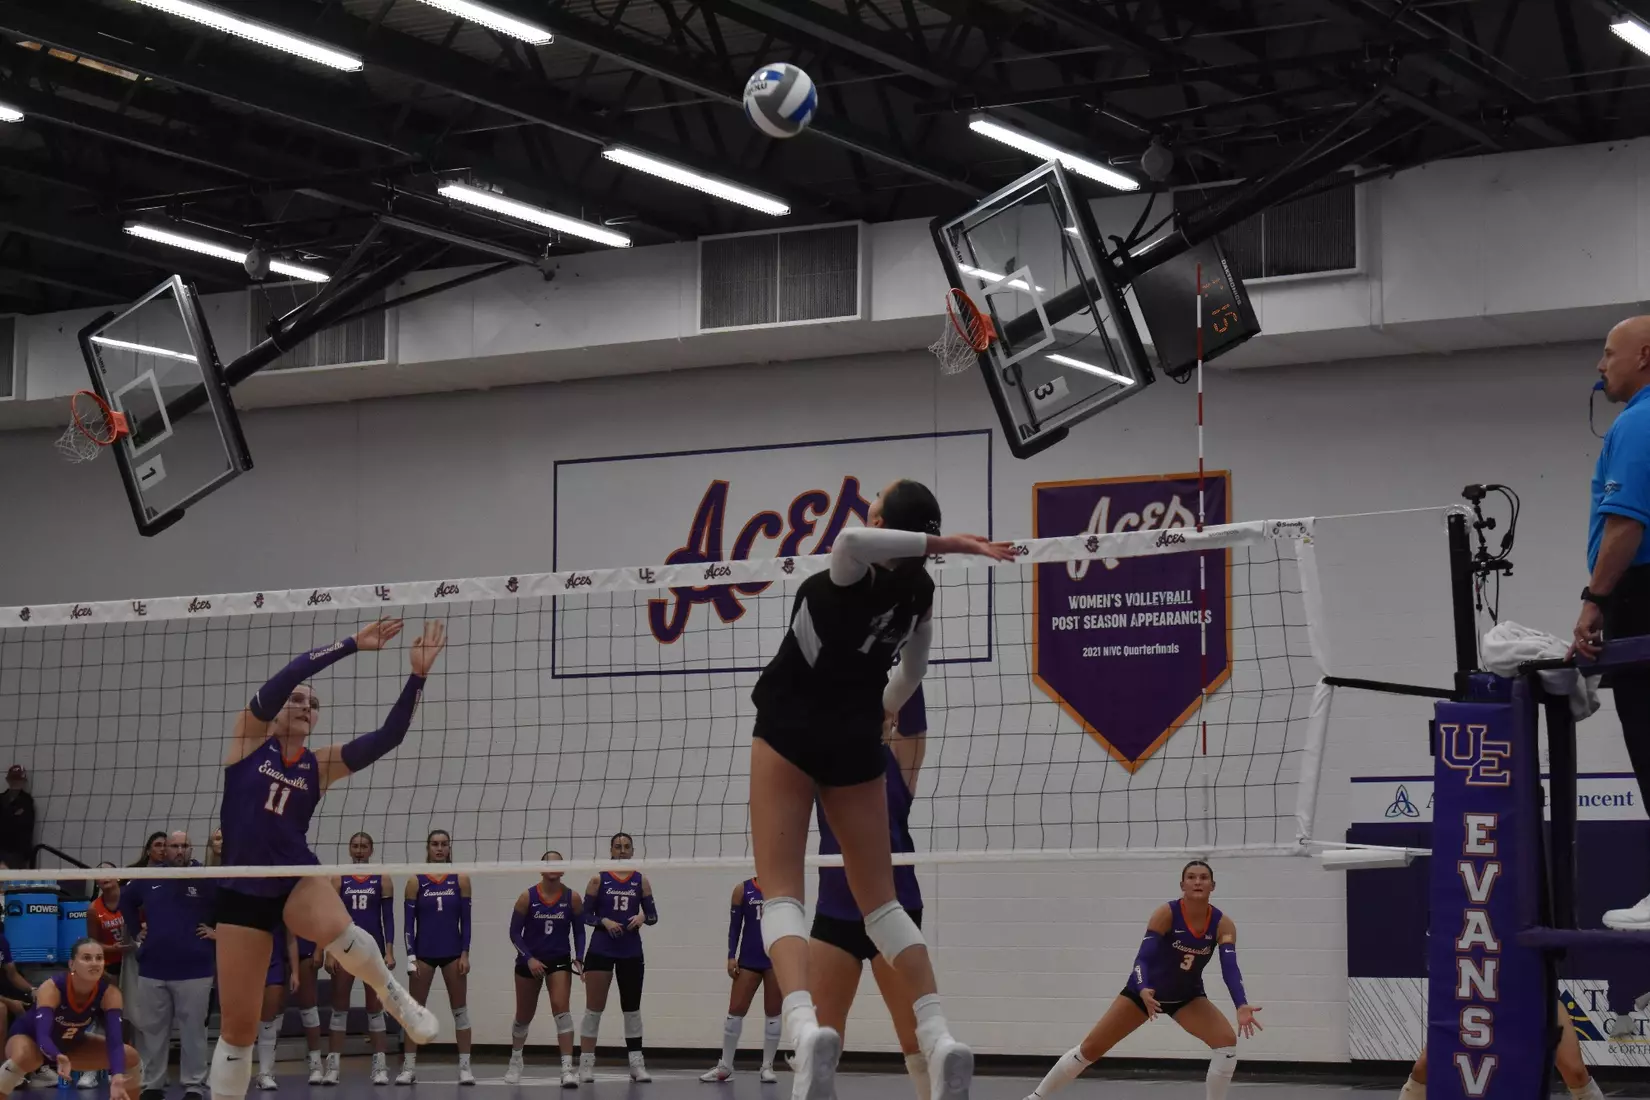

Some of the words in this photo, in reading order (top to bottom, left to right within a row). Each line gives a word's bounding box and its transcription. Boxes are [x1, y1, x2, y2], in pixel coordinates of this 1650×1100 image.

[1155, 529, 1186, 548] Aces
[703, 563, 732, 580] Aces
[564, 573, 592, 589] Aces
[434, 581, 460, 598] Aces
[188, 597, 212, 612] Aces
[307, 590, 332, 606] Aces
[1068, 593, 1122, 610] WOMEN'S
[1125, 589, 1193, 607] VOLLEYBALL
[70, 604, 92, 619] Aces
[1051, 615, 1080, 631] POST
[1083, 613, 1127, 630] SEASON
[1129, 609, 1212, 628] APPEARANCES
[1082, 645, 1101, 658] 2021
[1123, 642, 1180, 657] Quarterfinals
[258, 758, 309, 791] Evansville
[263, 782, 292, 817] 11
[1577, 790, 1635, 807] ncent
[351, 894, 368, 910] 18
[436, 896, 444, 911] 1
[613, 896, 629, 912] 13
[544, 920, 554, 935] 6
[1179, 954, 1195, 971] 3
[61, 1027, 79, 1040] 2
